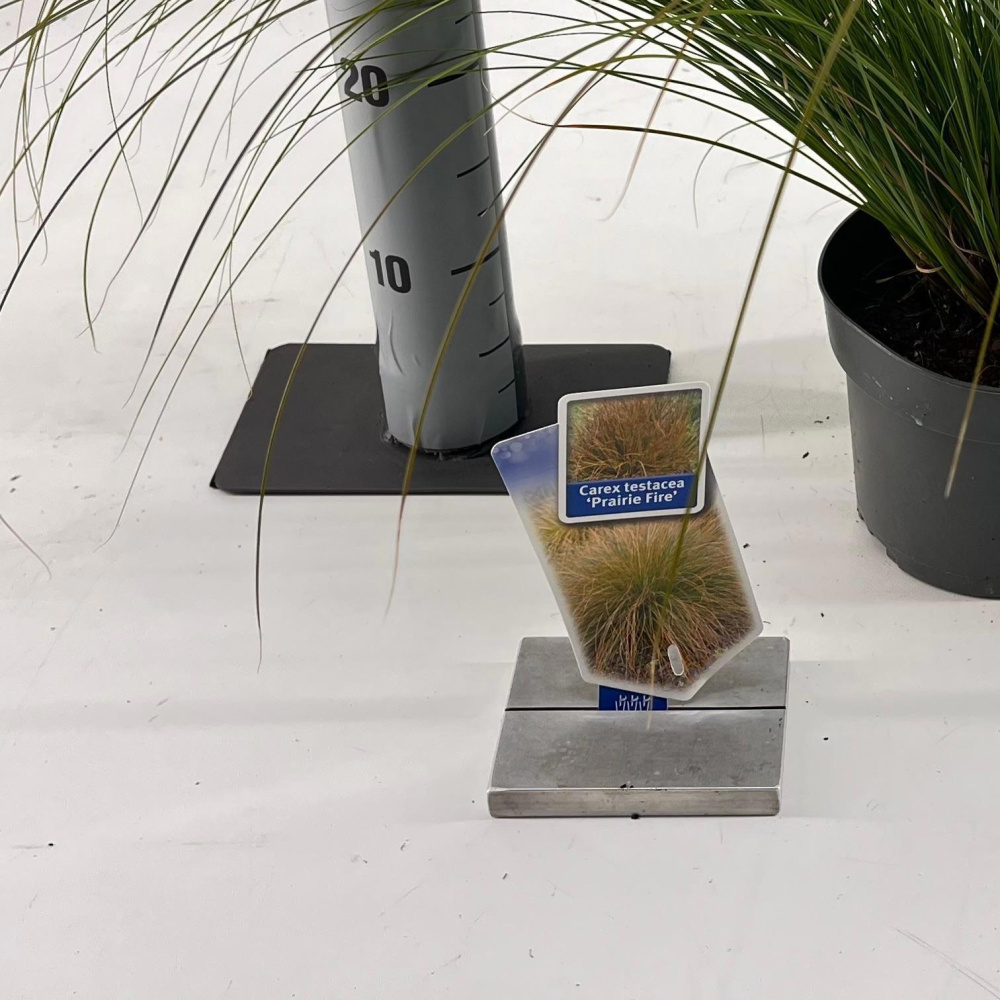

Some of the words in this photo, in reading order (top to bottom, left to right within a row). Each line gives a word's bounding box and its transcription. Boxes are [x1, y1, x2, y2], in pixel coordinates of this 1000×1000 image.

[341, 57, 390, 108] 20
[369, 248, 412, 294] 10
[579, 484, 621, 496] Carex
[624, 479, 685, 493] testacea
